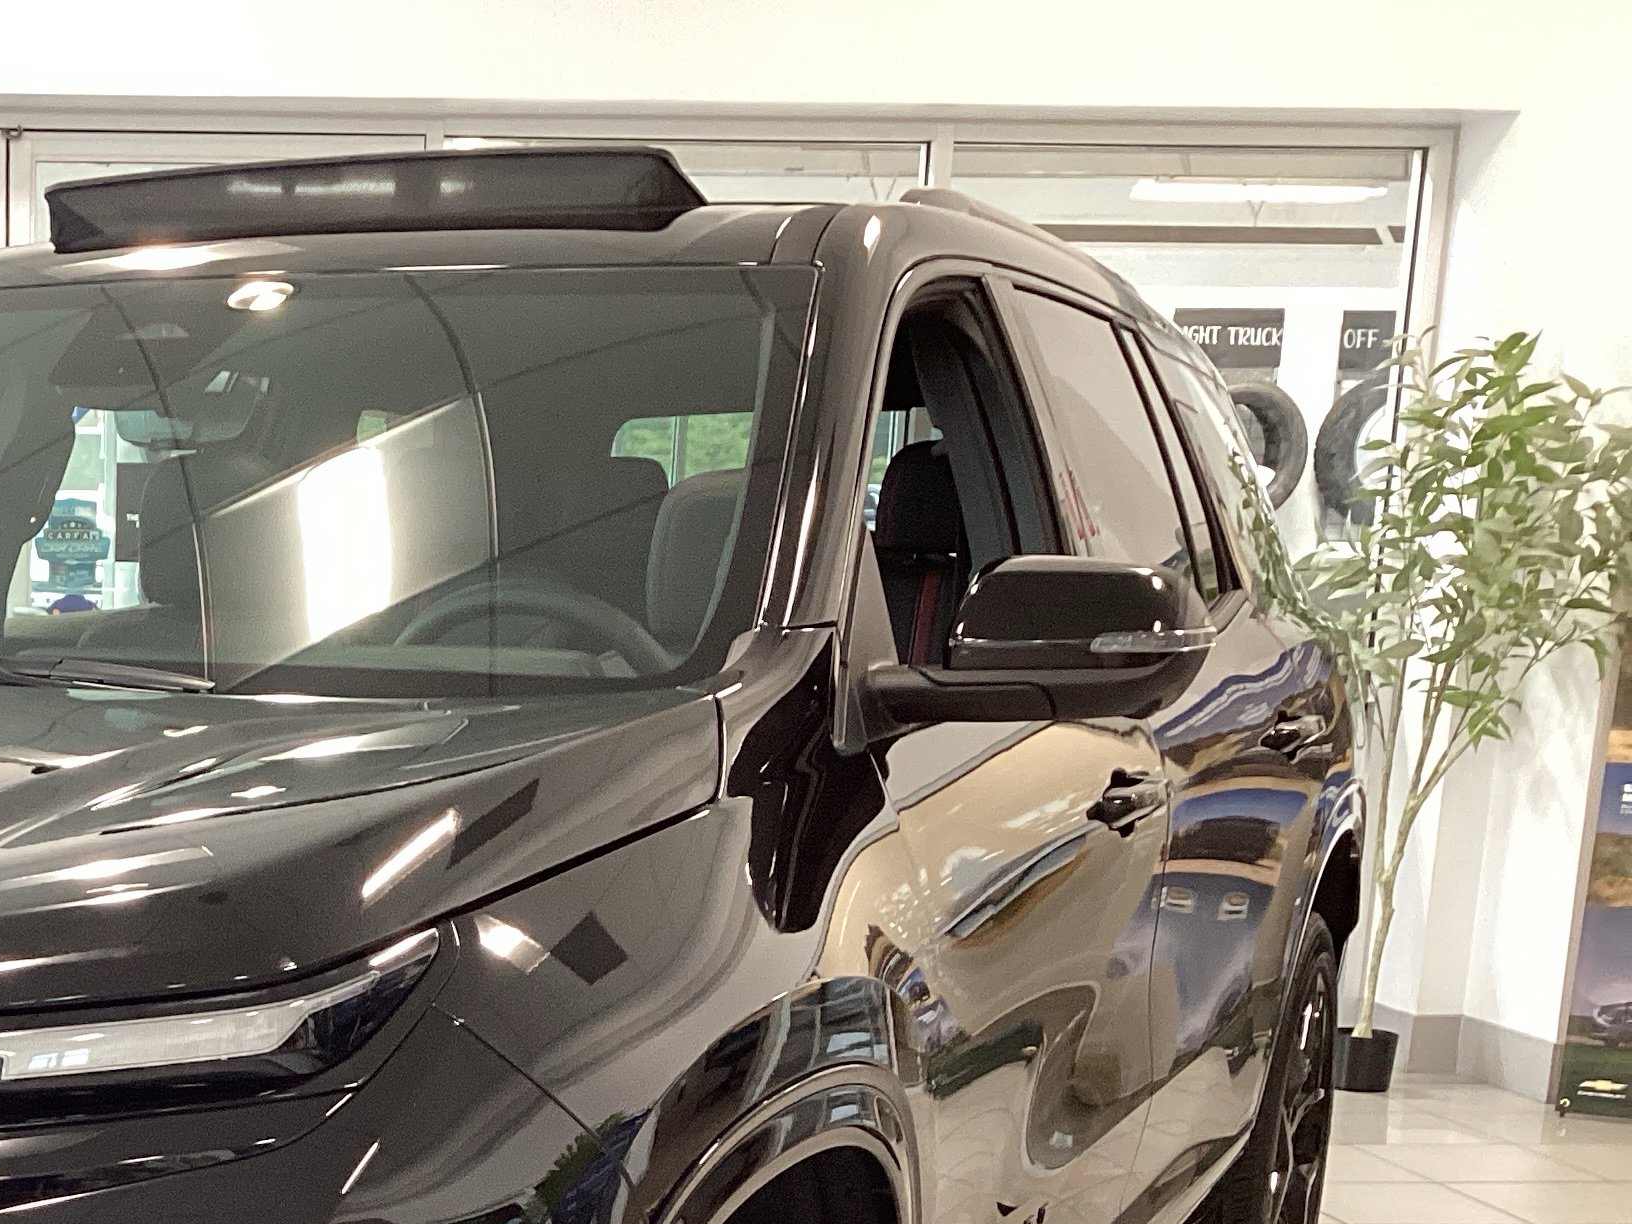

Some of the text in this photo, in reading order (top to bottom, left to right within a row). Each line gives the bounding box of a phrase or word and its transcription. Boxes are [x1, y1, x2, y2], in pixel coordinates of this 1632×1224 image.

[1180, 325, 1284, 346] GHT TRUCK
[1343, 328, 1380, 349] OFF
